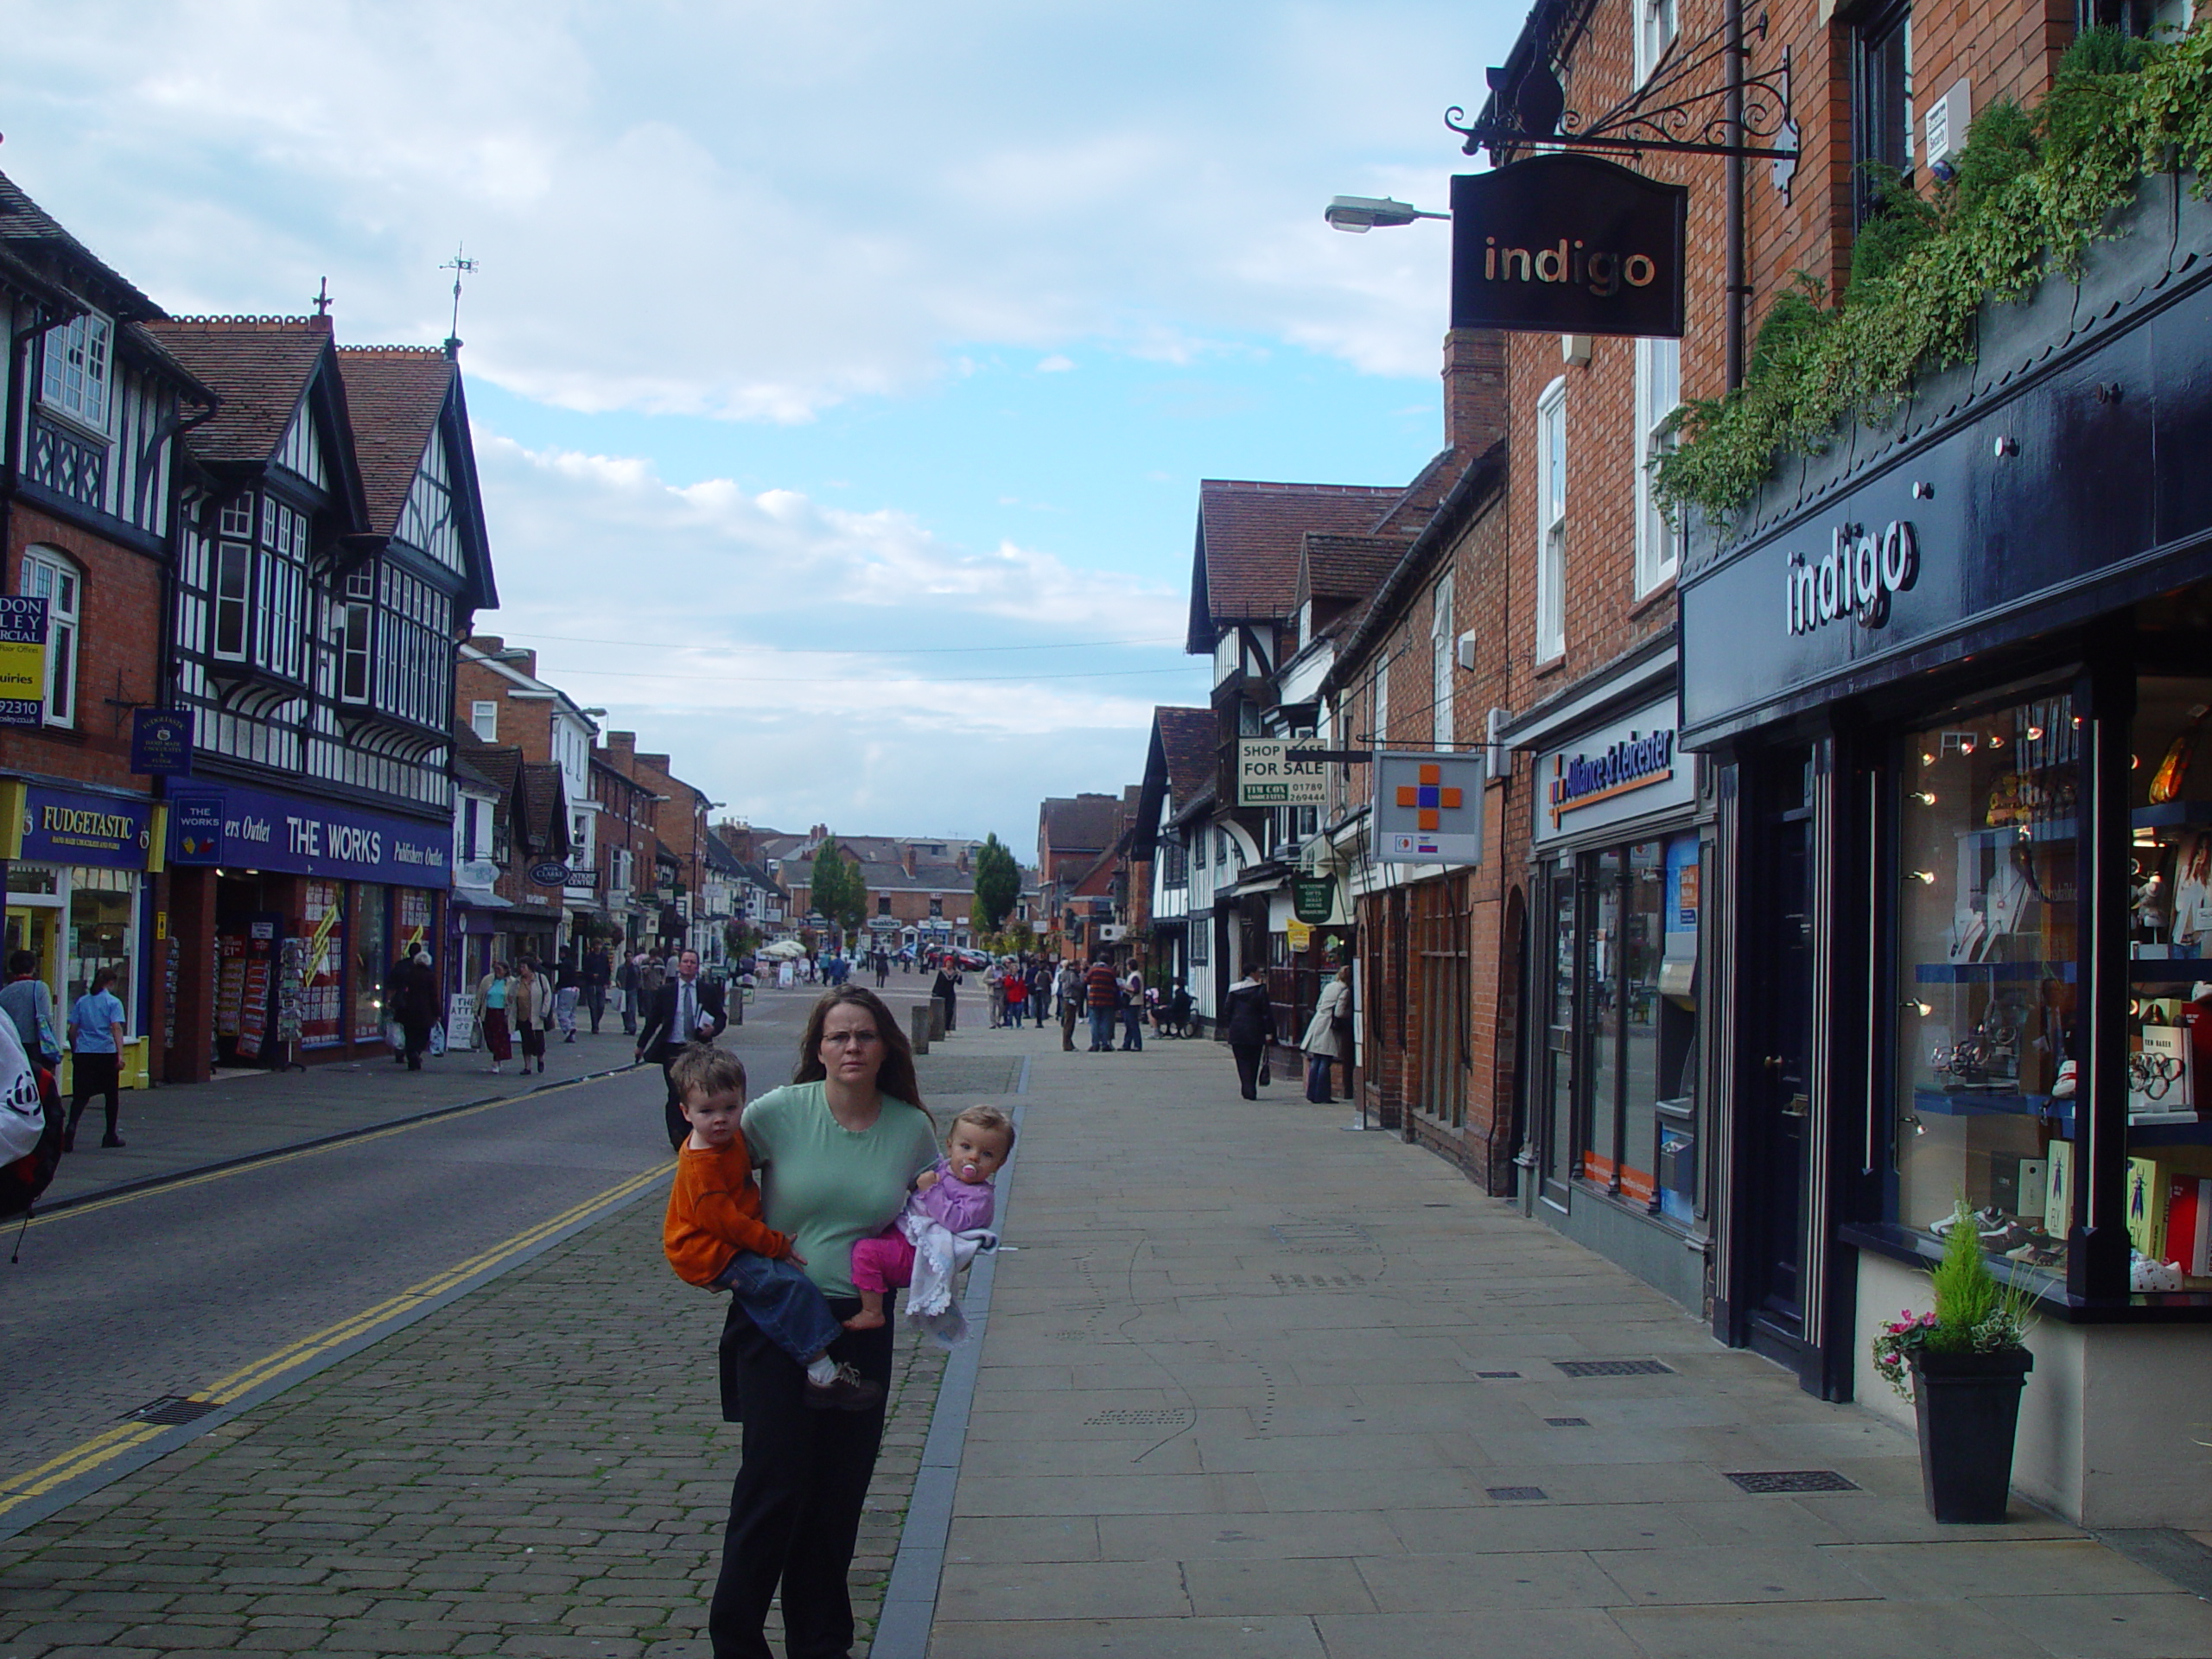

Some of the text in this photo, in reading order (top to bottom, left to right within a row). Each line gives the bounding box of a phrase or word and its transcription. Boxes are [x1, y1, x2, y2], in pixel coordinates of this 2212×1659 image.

[1484, 236, 1656, 296] indigo
[1786, 520, 1908, 637] indigo
[1243, 746, 1281, 757] SHOP
[1244, 762, 1325, 776] FOR SALE
[1566, 729, 1674, 798] Alliance & Leicester
[1246, 785, 1286, 794] TIM COX
[1290, 793, 1325, 802] 269444
[190, 807, 211, 817] THE
[44, 805, 134, 840] FUDGETASTIC
[180, 817, 220, 827] WORKS
[243, 815, 271, 842] Outlet
[286, 815, 321, 857] THE
[327, 823, 382, 865] WORKS
[393, 840, 424, 865] Publishers
[424, 846, 443, 867] Outlet
